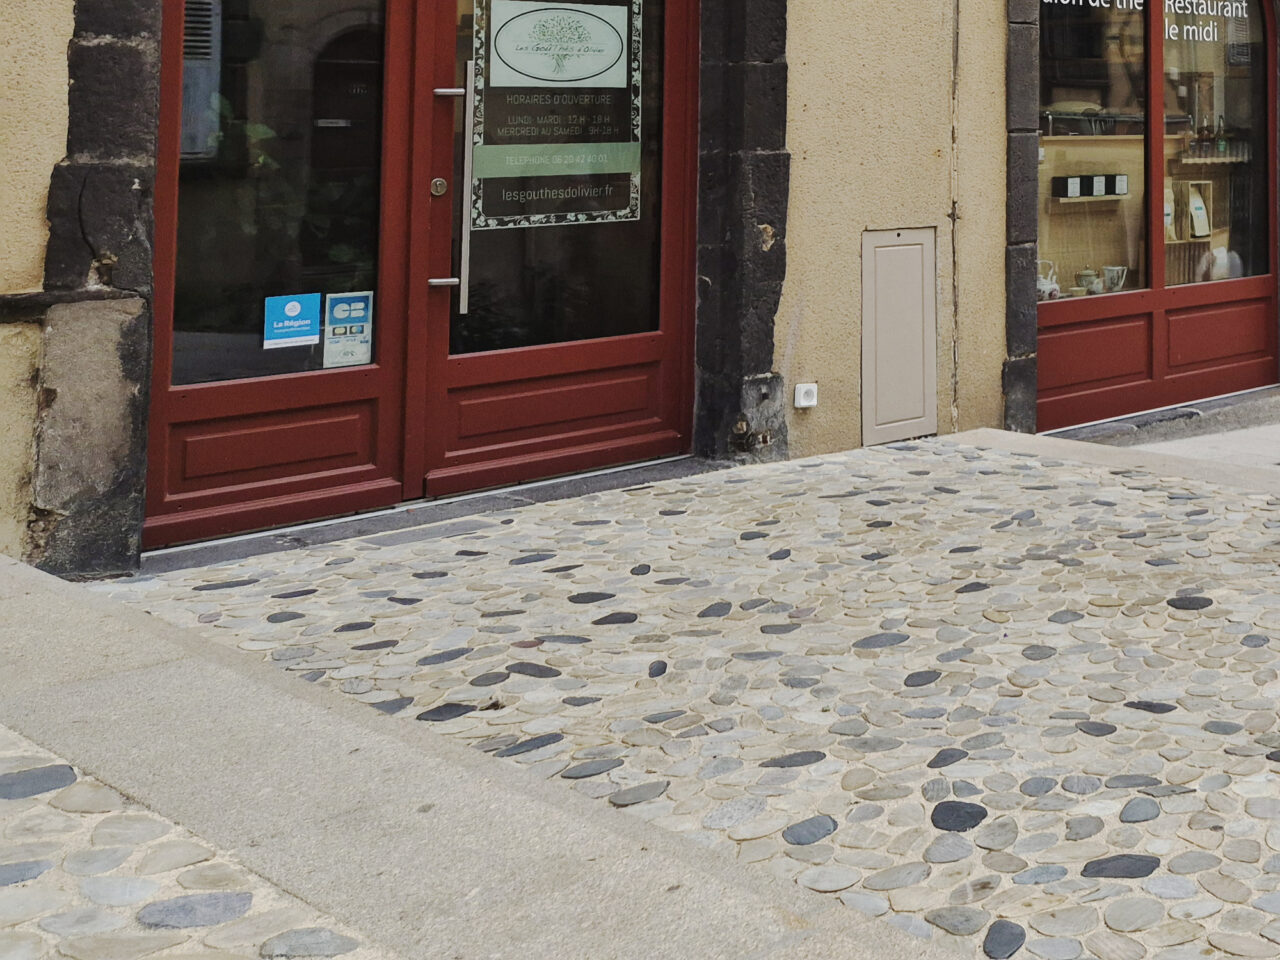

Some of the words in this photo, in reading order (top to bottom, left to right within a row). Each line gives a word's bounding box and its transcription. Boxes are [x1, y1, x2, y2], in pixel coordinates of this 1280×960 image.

[1164, 18, 1179, 40] le
[1183, 21, 1218, 42] midi
[506, 94, 550, 105] HORAIRES
[553, 94, 612, 104] D'OUVERTURE
[497, 126, 539, 136] MERCREDI
[541, 127, 551, 136] AU
[598, 153, 608, 163] 01
[502, 184, 613, 203] lesgouthesdolivier.fr
[333, 302, 365, 319] CB
[284, 319, 311, 328] Région
